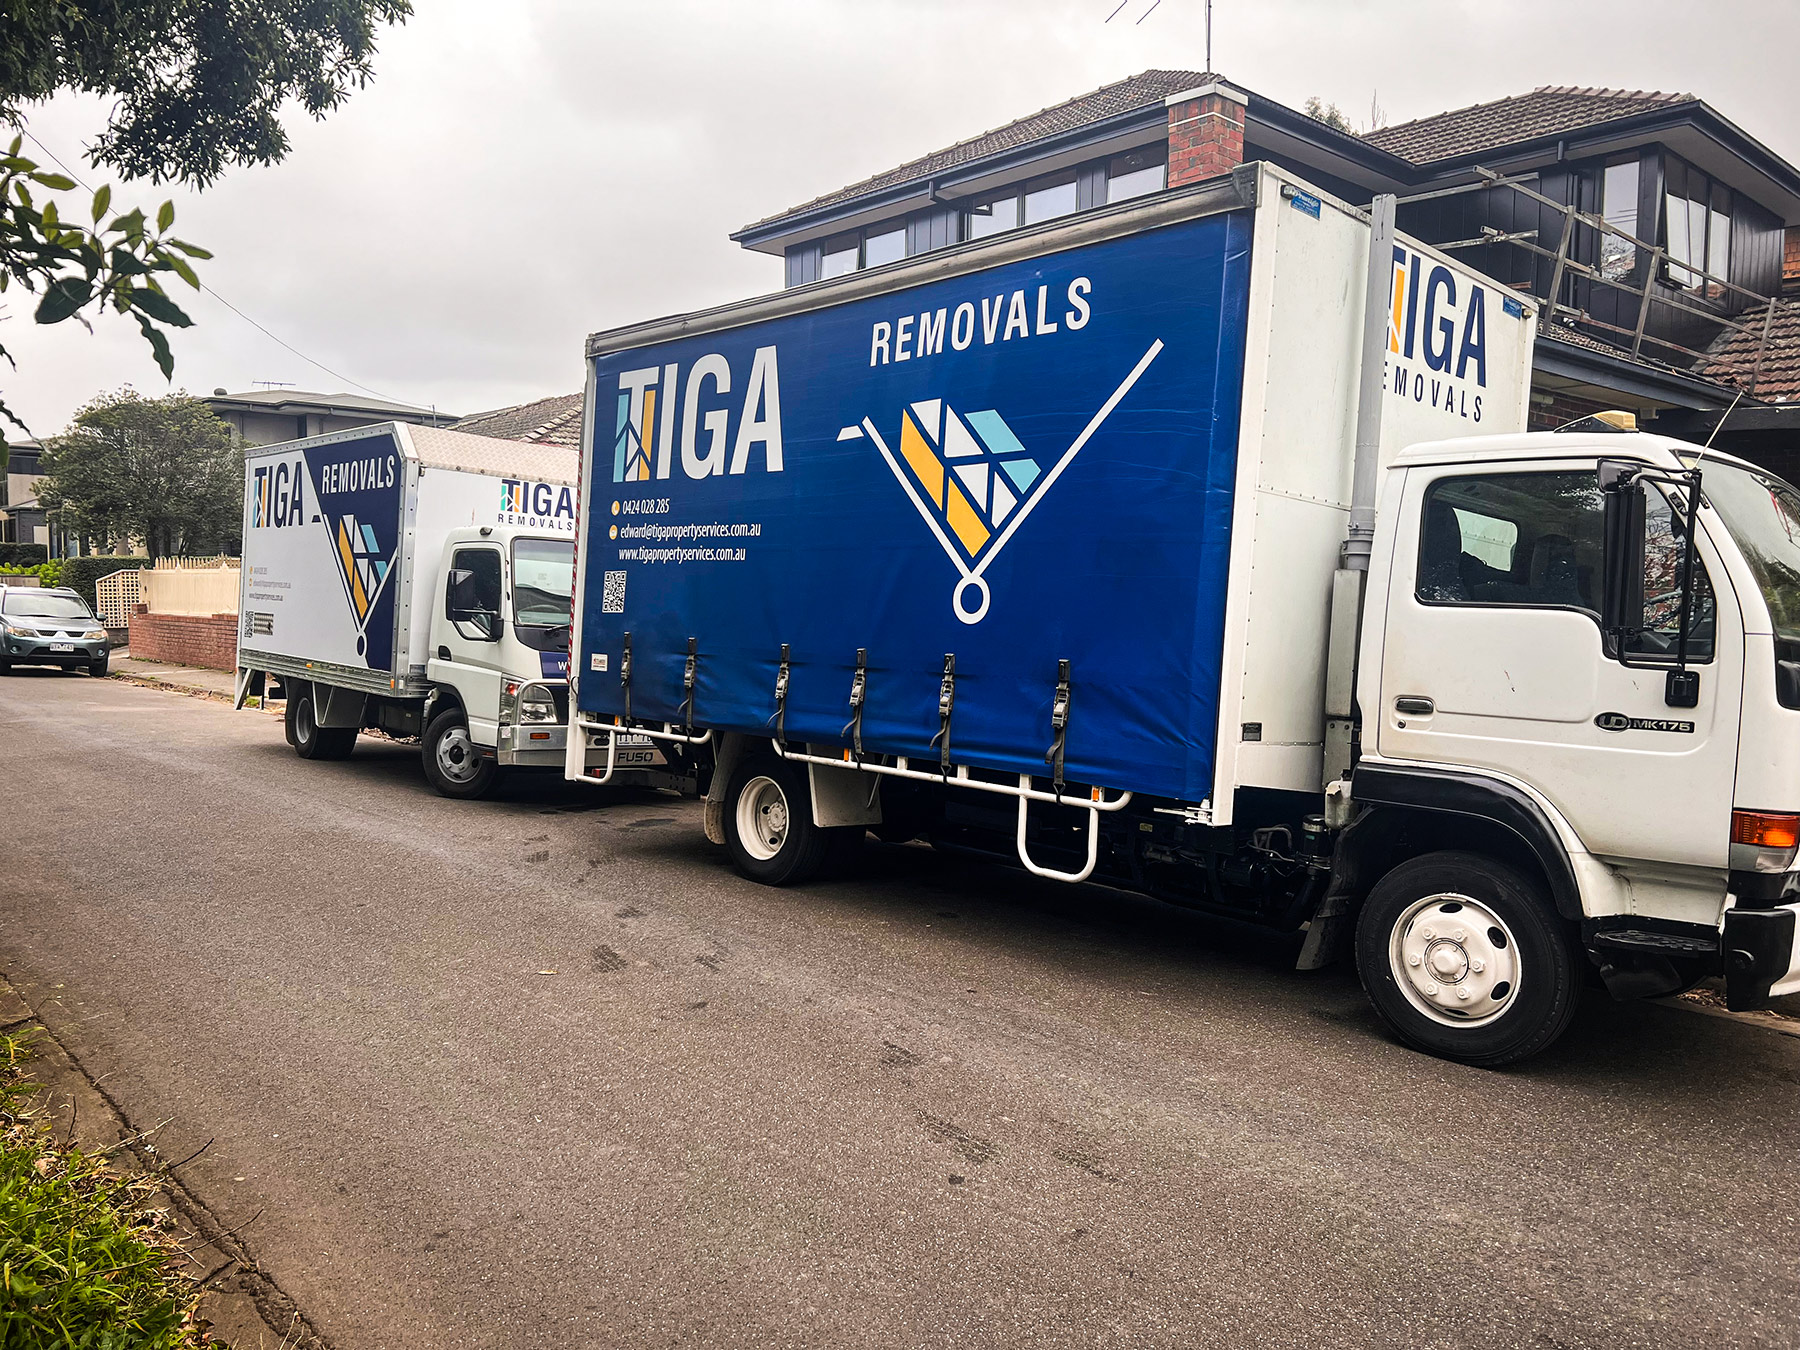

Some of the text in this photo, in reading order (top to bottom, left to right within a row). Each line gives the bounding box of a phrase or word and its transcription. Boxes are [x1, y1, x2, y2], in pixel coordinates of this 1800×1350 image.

[869, 276, 1092, 367] REMOVALS
[1383, 361, 1482, 422] MOVALS
[613, 345, 784, 483] TIGA
[322, 455, 395, 494] REMOVALS
[252, 461, 304, 528] TIGA
[501, 479, 574, 519] TIGA
[622, 498, 670, 515] 0424 028 285
[498, 513, 573, 530] REMOVALS
[620, 522, 761, 541] edward@tigapropertyservices.com.au
[618, 545, 746, 564] www.tigapropertyservices.com.au
[1633, 720, 1691, 731] MK175
[617, 752, 654, 763] FUSO
